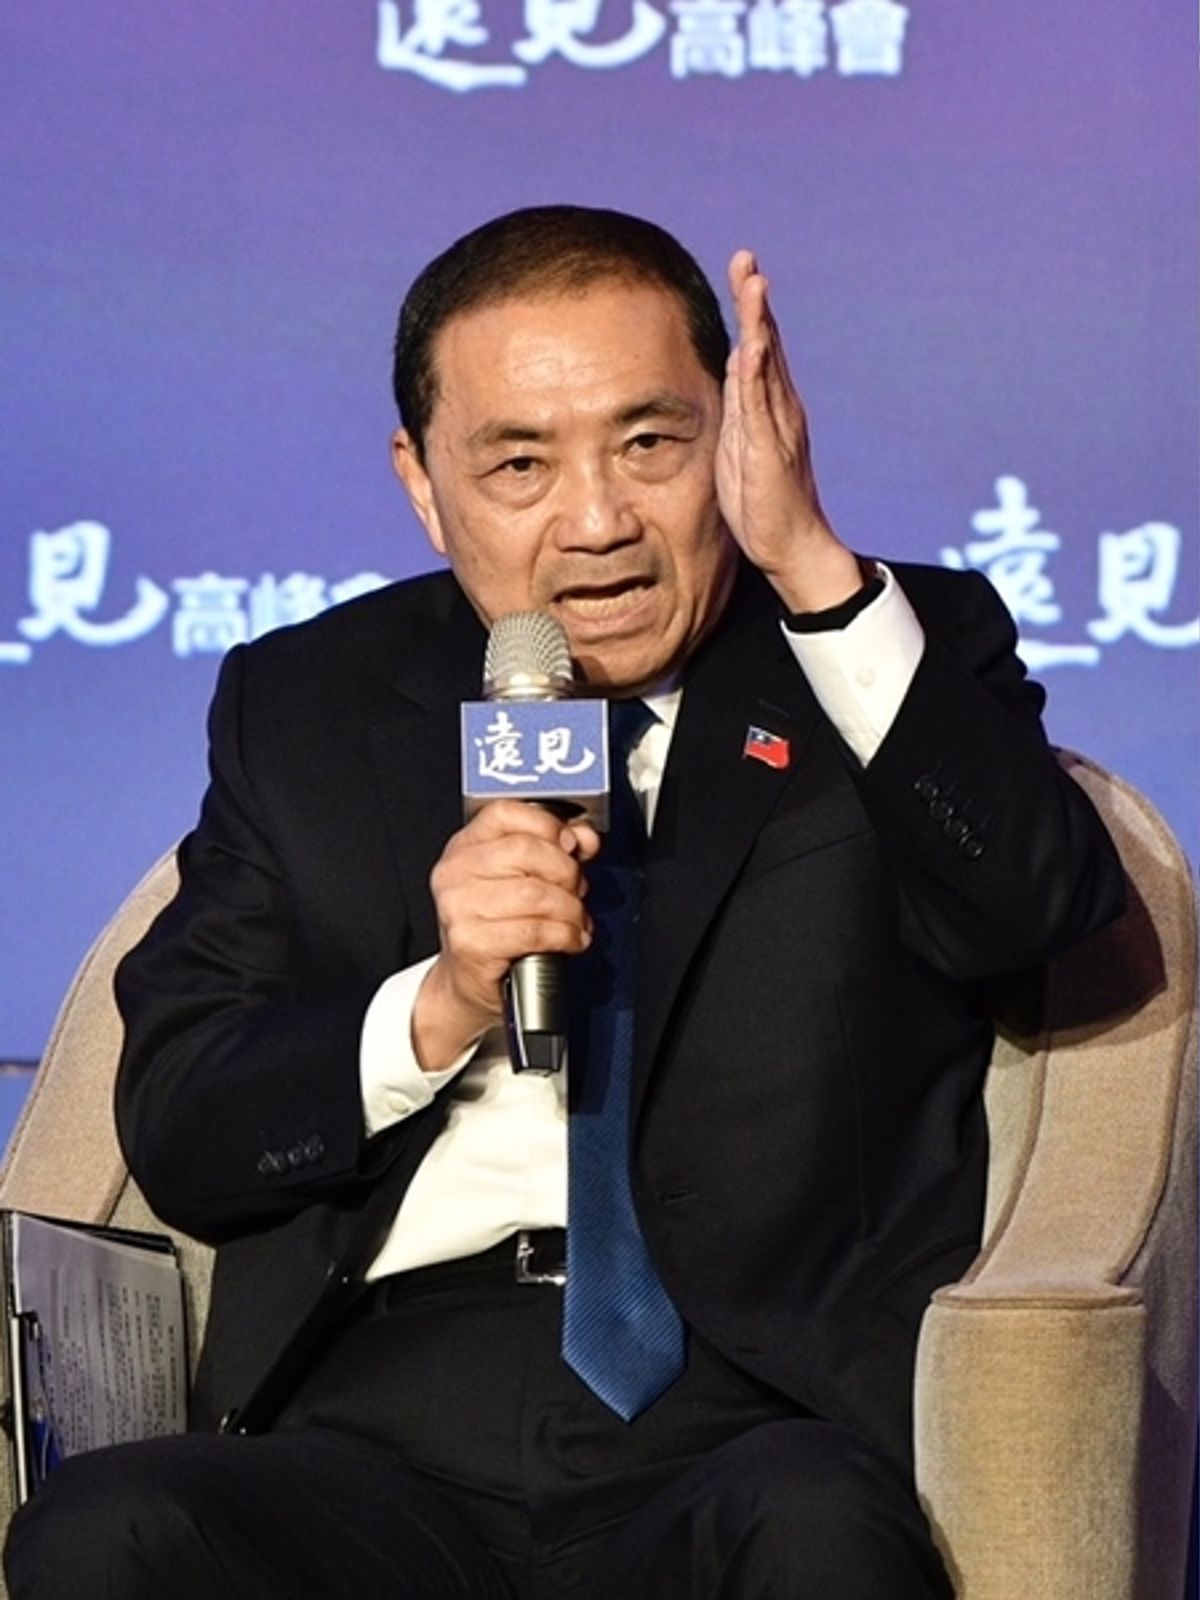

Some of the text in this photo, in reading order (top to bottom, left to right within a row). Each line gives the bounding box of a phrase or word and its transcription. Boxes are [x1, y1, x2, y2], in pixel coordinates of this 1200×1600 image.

[0, 520, 395, 663] 見高峰
[474, 711, 596, 785] 遠見
